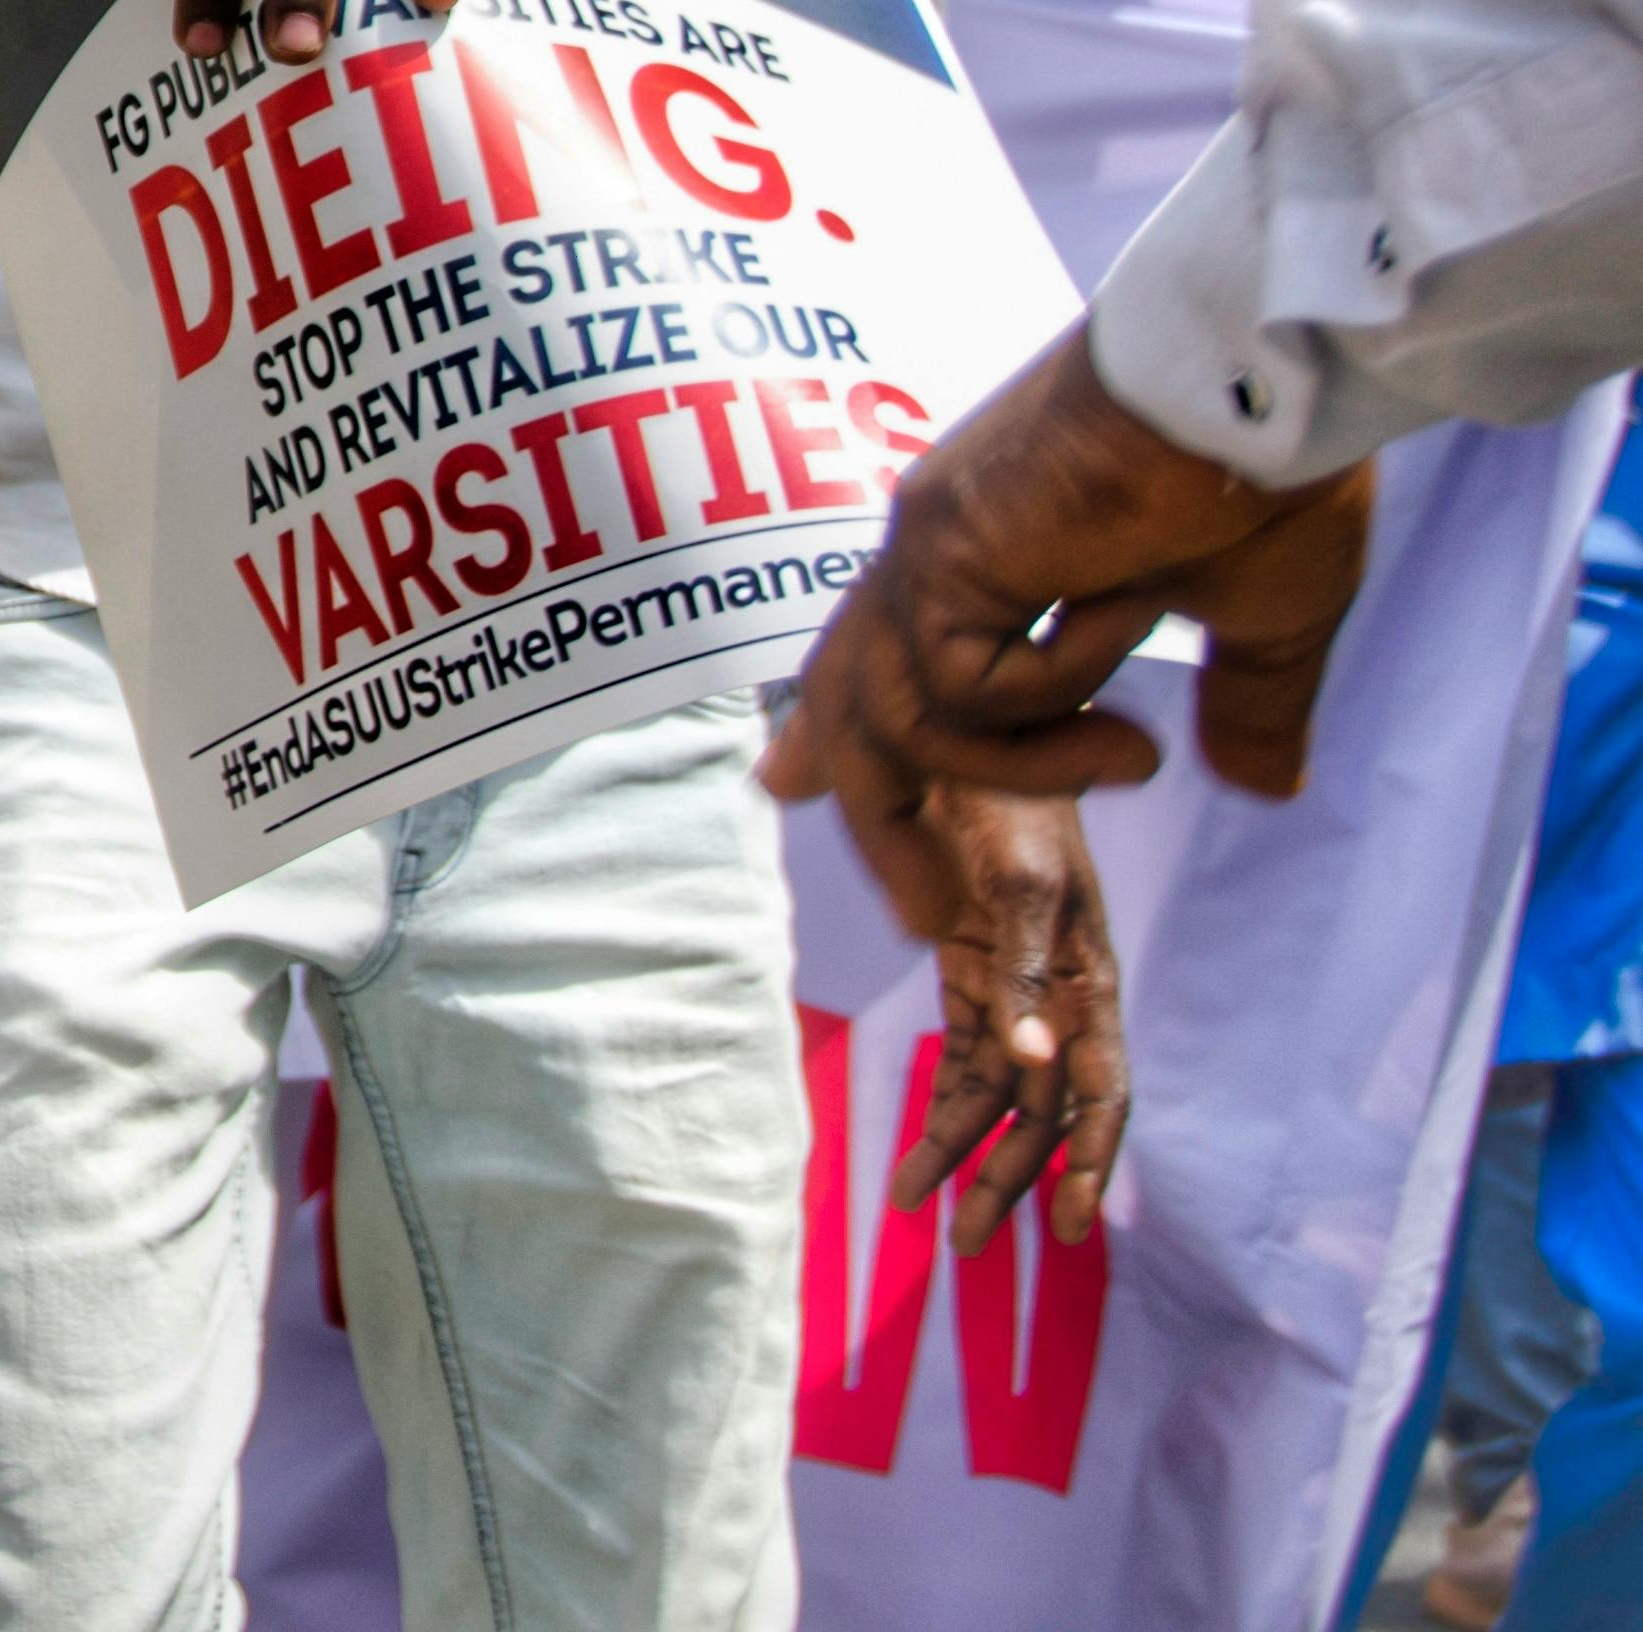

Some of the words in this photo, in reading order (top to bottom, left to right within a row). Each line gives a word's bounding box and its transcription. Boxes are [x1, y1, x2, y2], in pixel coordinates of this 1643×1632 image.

[94, 91, 151, 175] FG
[149, 9, 268, 139] PUBLI
[678, 14, 790, 83] ARE
[128, 39, 856, 382] DIEING.
[243, 424, 327, 525] AND
[326, 301, 700, 473] REVITALIZE
[713, 300, 872, 365] OUR
[253, 306, 363, 418] STOP
[363, 254, 491, 356] THE
[501, 226, 773, 305] STRIKE
[233, 376, 932, 688] VARSITIES
[219, 546, 879, 811] #EndASUUStrikePermane
